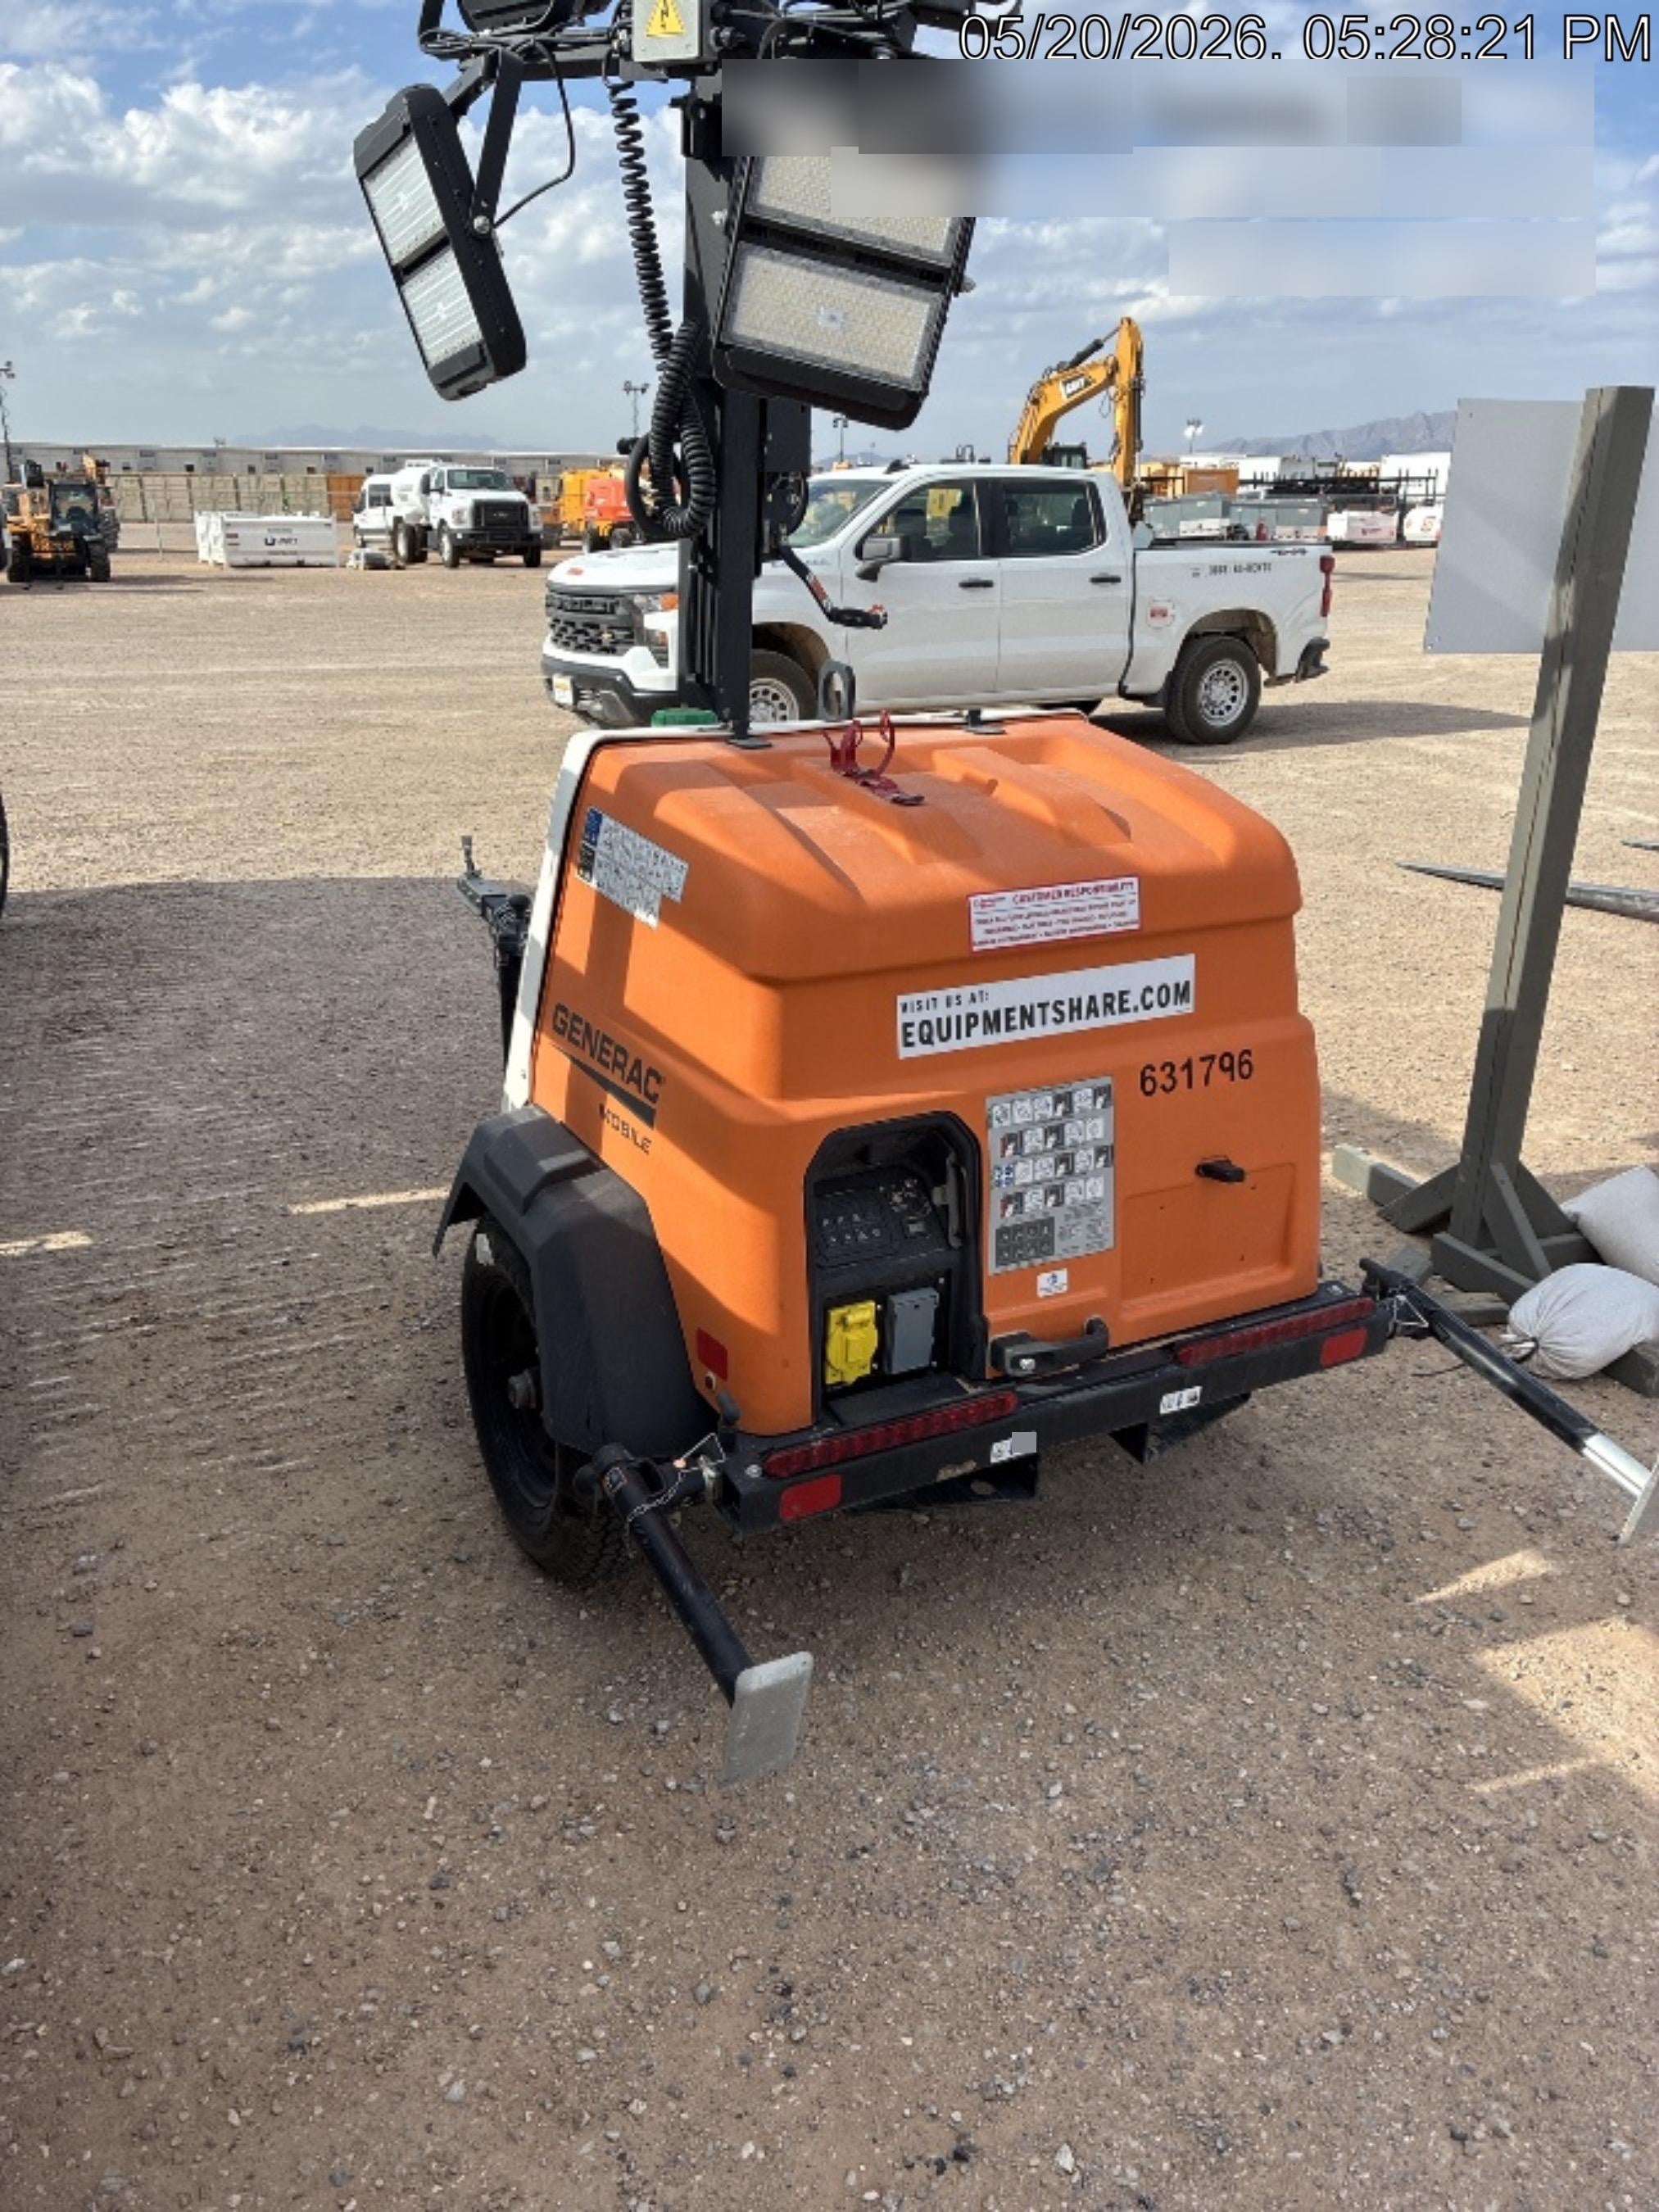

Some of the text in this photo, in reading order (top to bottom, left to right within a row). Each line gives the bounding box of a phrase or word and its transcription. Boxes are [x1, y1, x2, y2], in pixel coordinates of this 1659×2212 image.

[900, 990, 990, 1013] VISIT US AT:
[901, 979, 1191, 1048] EQUIPMENTSHARE.COM
[552, 1002, 662, 1104] GENERAC
[1140, 1048, 1254, 1097] 631796
[599, 1103, 652, 1155] MOBILE
